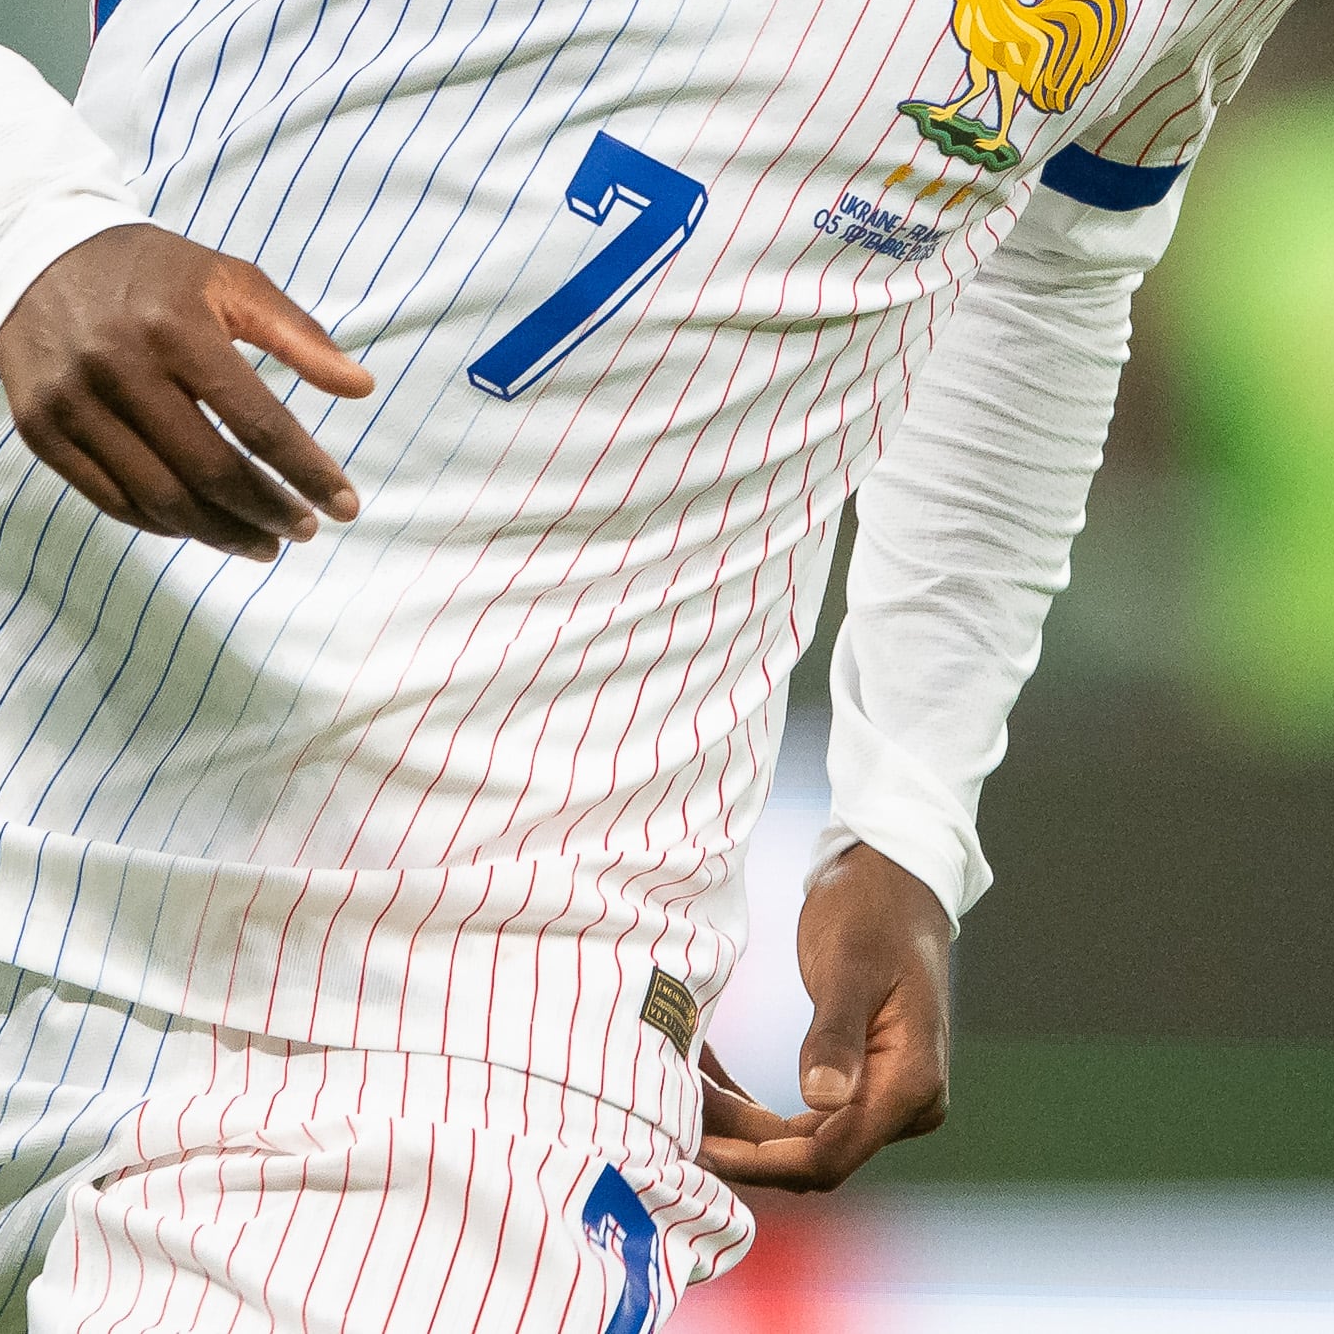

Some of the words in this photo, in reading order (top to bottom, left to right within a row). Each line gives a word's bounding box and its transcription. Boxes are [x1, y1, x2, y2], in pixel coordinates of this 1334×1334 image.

[465, 130, 709, 402] 7
[813, 208, 842, 235] 05
[839, 192, 903, 234] UKRAINE
[582, 1162, 660, 1334] 7
